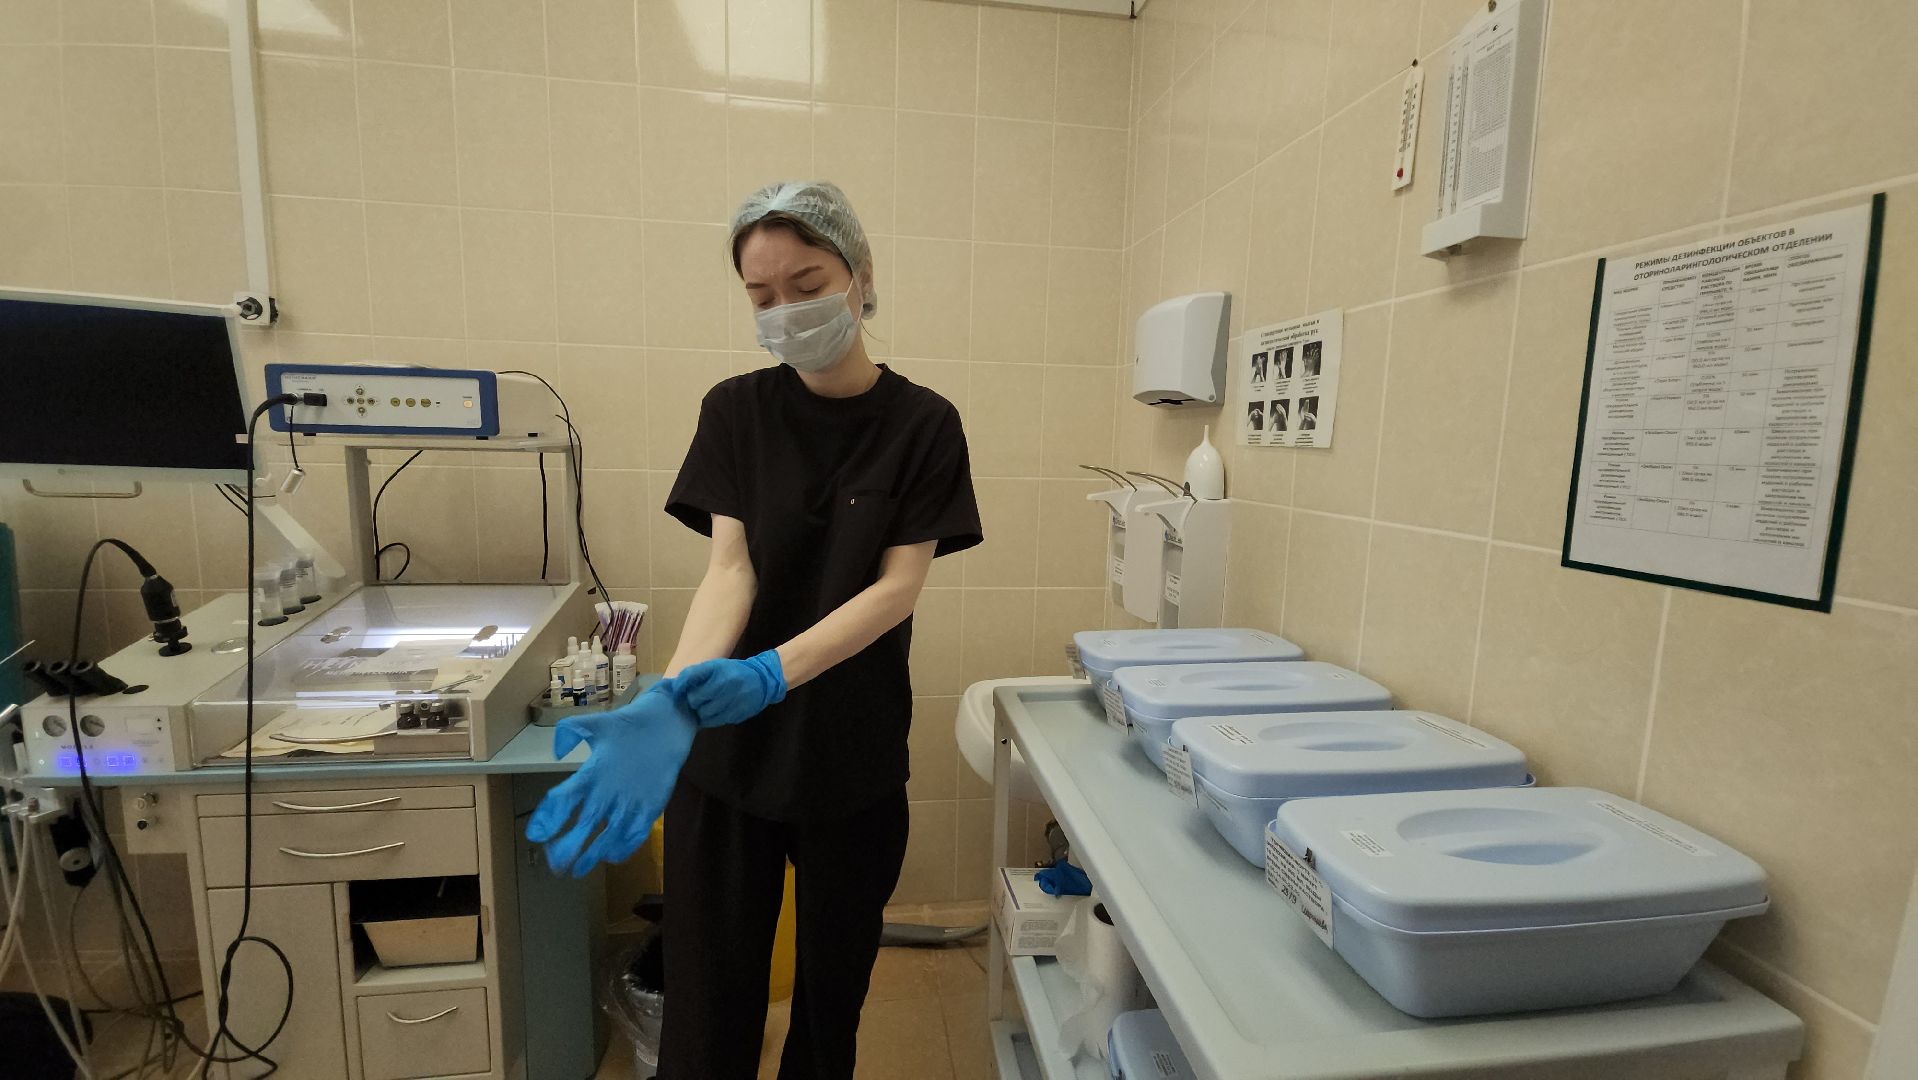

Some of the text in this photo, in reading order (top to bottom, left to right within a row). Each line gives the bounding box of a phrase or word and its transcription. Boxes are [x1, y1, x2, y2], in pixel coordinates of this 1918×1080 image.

[1634, 227, 1796, 270] РЕЖИМЫ ДЕЗИНФЕКЦИИ ОБЪЕКТОВ В
[1771, 232, 1833, 253] ОТДЕЛЕНИИ
